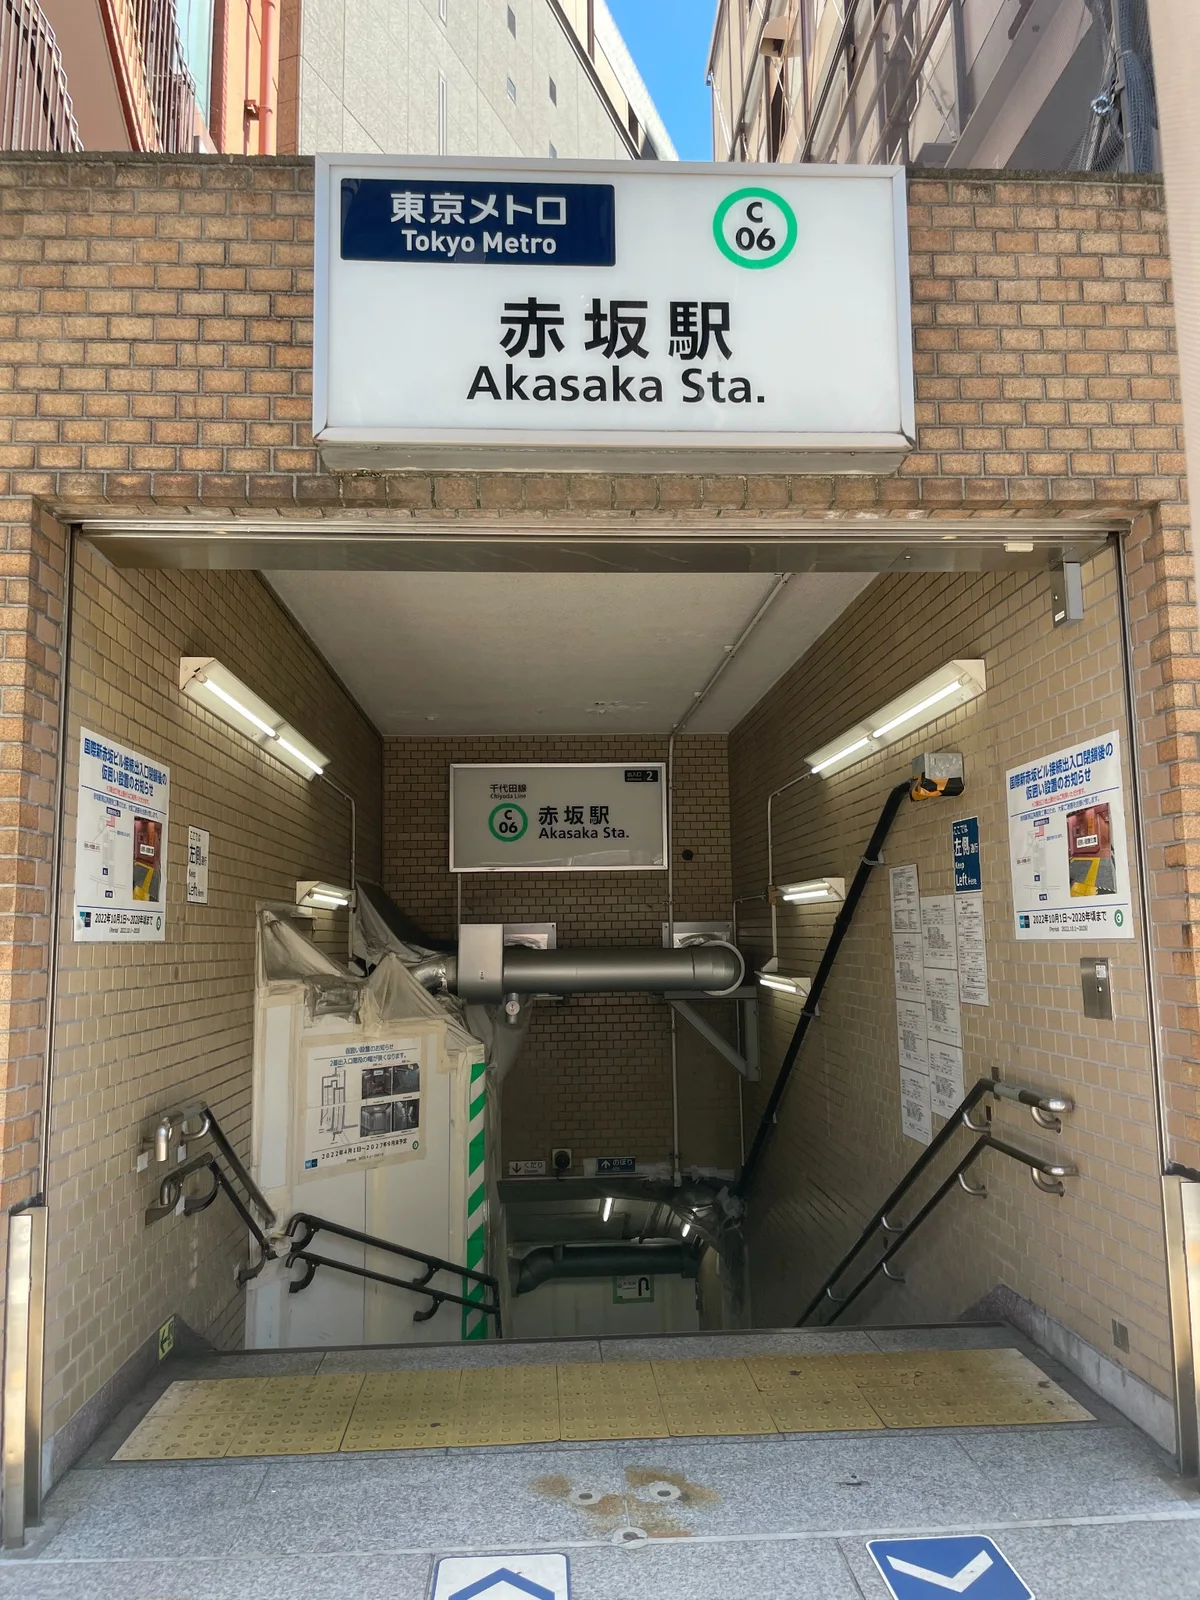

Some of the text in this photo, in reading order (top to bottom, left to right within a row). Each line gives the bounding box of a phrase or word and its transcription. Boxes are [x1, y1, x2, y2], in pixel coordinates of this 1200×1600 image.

[390, 191, 567, 227] 東京メトロ
[746, 202, 764, 224] C
[401, 230, 557, 256] Tokyo Metro
[735, 226, 777, 252] 06
[498, 297, 733, 361] 赤坂駅
[466, 364, 766, 404] Akasaka Sta.
[646, 771, 654, 781] 2
[1009, 742, 1114, 790] 国際新赤坂ビル接続出入口閉鎖後の
[489, 784, 528, 793] 千代田線
[1025, 767, 1092, 801] 仮囲い設置のお知らせ
[504, 809, 513, 821] C
[538, 805, 610, 825] 赤坂駅
[499, 822, 518, 834] 06
[538, 826, 630, 839] Akasaka Sta.
[955, 861, 965, 870] Keep
[955, 872, 968, 887] Left
[524, 1161, 543, 1169] くだり
